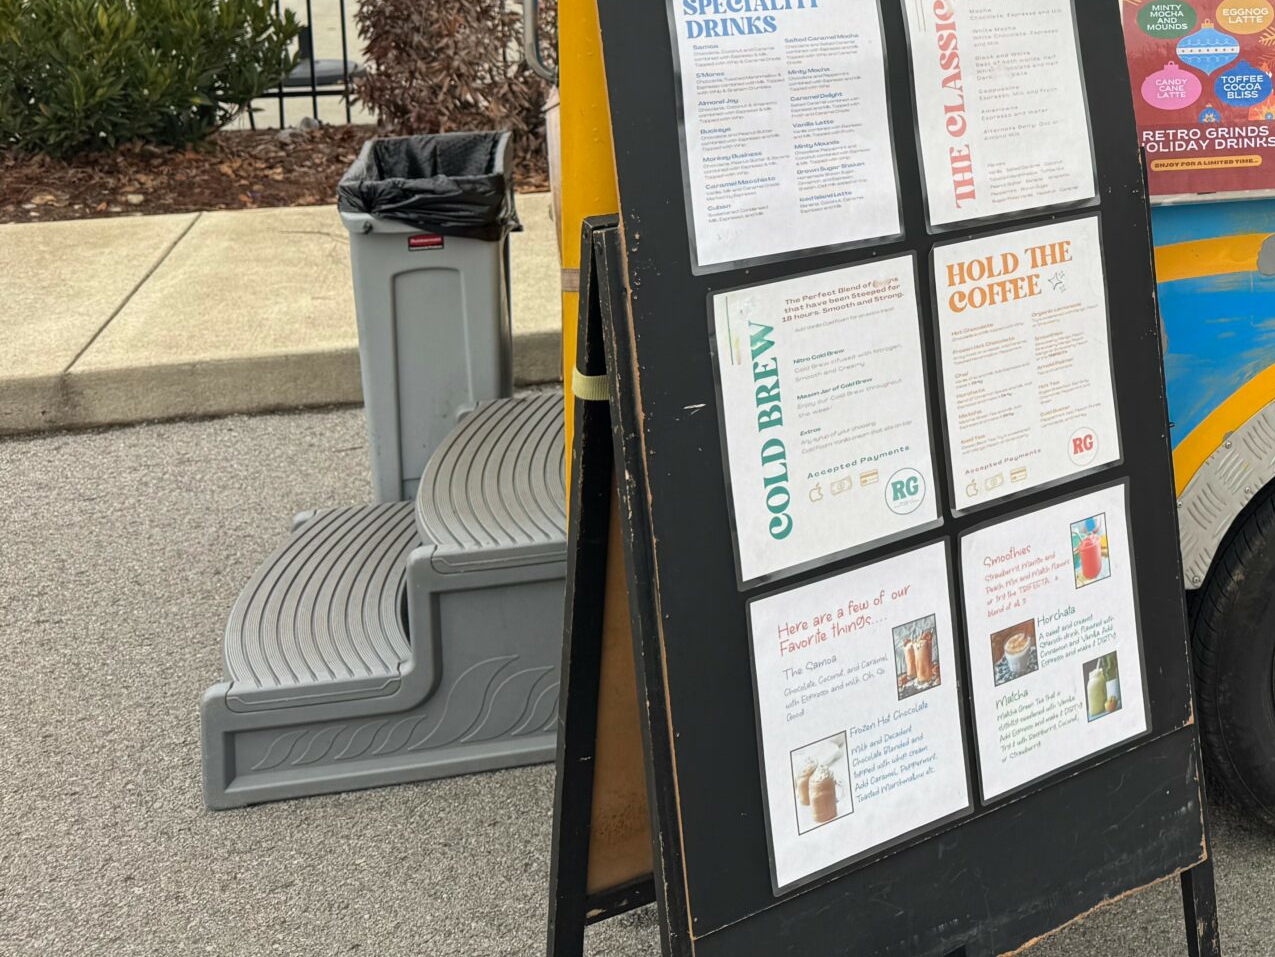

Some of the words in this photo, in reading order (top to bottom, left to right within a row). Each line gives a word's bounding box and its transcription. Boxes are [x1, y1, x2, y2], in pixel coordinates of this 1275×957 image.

[1222, 8, 1269, 17] EGGNOG
[1228, 16, 1264, 24] LATTE
[685, 15, 778, 39] DRINKS
[1155, 78, 1188, 86] CANDY
[1221, 75, 1264, 84] TOFFEE
[1223, 83, 1262, 91] COCOA
[1226, 91, 1259, 99] BLISS
[1142, 128, 1201, 141] RETRO
[1206, 126, 1270, 138] GRINDS
[1141, 140, 1212, 153] OLIDAY
[950, 144, 976, 209] THE
[946, 251, 1019, 287] HOLD
[1024, 240, 1073, 270] THE
[948, 274, 1042, 313] COFFEE
[748, 319, 784, 433] BREW
[1072, 434, 1094, 456] RG
[807, 461, 858, 479] Accepted
[860, 445, 911, 464] Payments
[761, 438, 793, 540] COLD
[891, 476, 920, 501] RG
[983, 544, 1032, 568] Smoothies
[777, 624, 808, 640] Here
[812, 613, 833, 627] are
[837, 608, 845, 618] a
[848, 599, 870, 615] few
[873, 590, 886, 607] of
[891, 584, 912, 601] our
[1037, 605, 1076, 628] Horchata
[779, 632, 828, 657] Favorite
[783, 666, 803, 681] The
[805, 655, 838, 673] Samoa
[995, 688, 1029, 711] Matcha
[849, 723, 875, 739] Frozen
[877, 714, 891, 727] Hot
[893, 701, 929, 722] Chocolate
